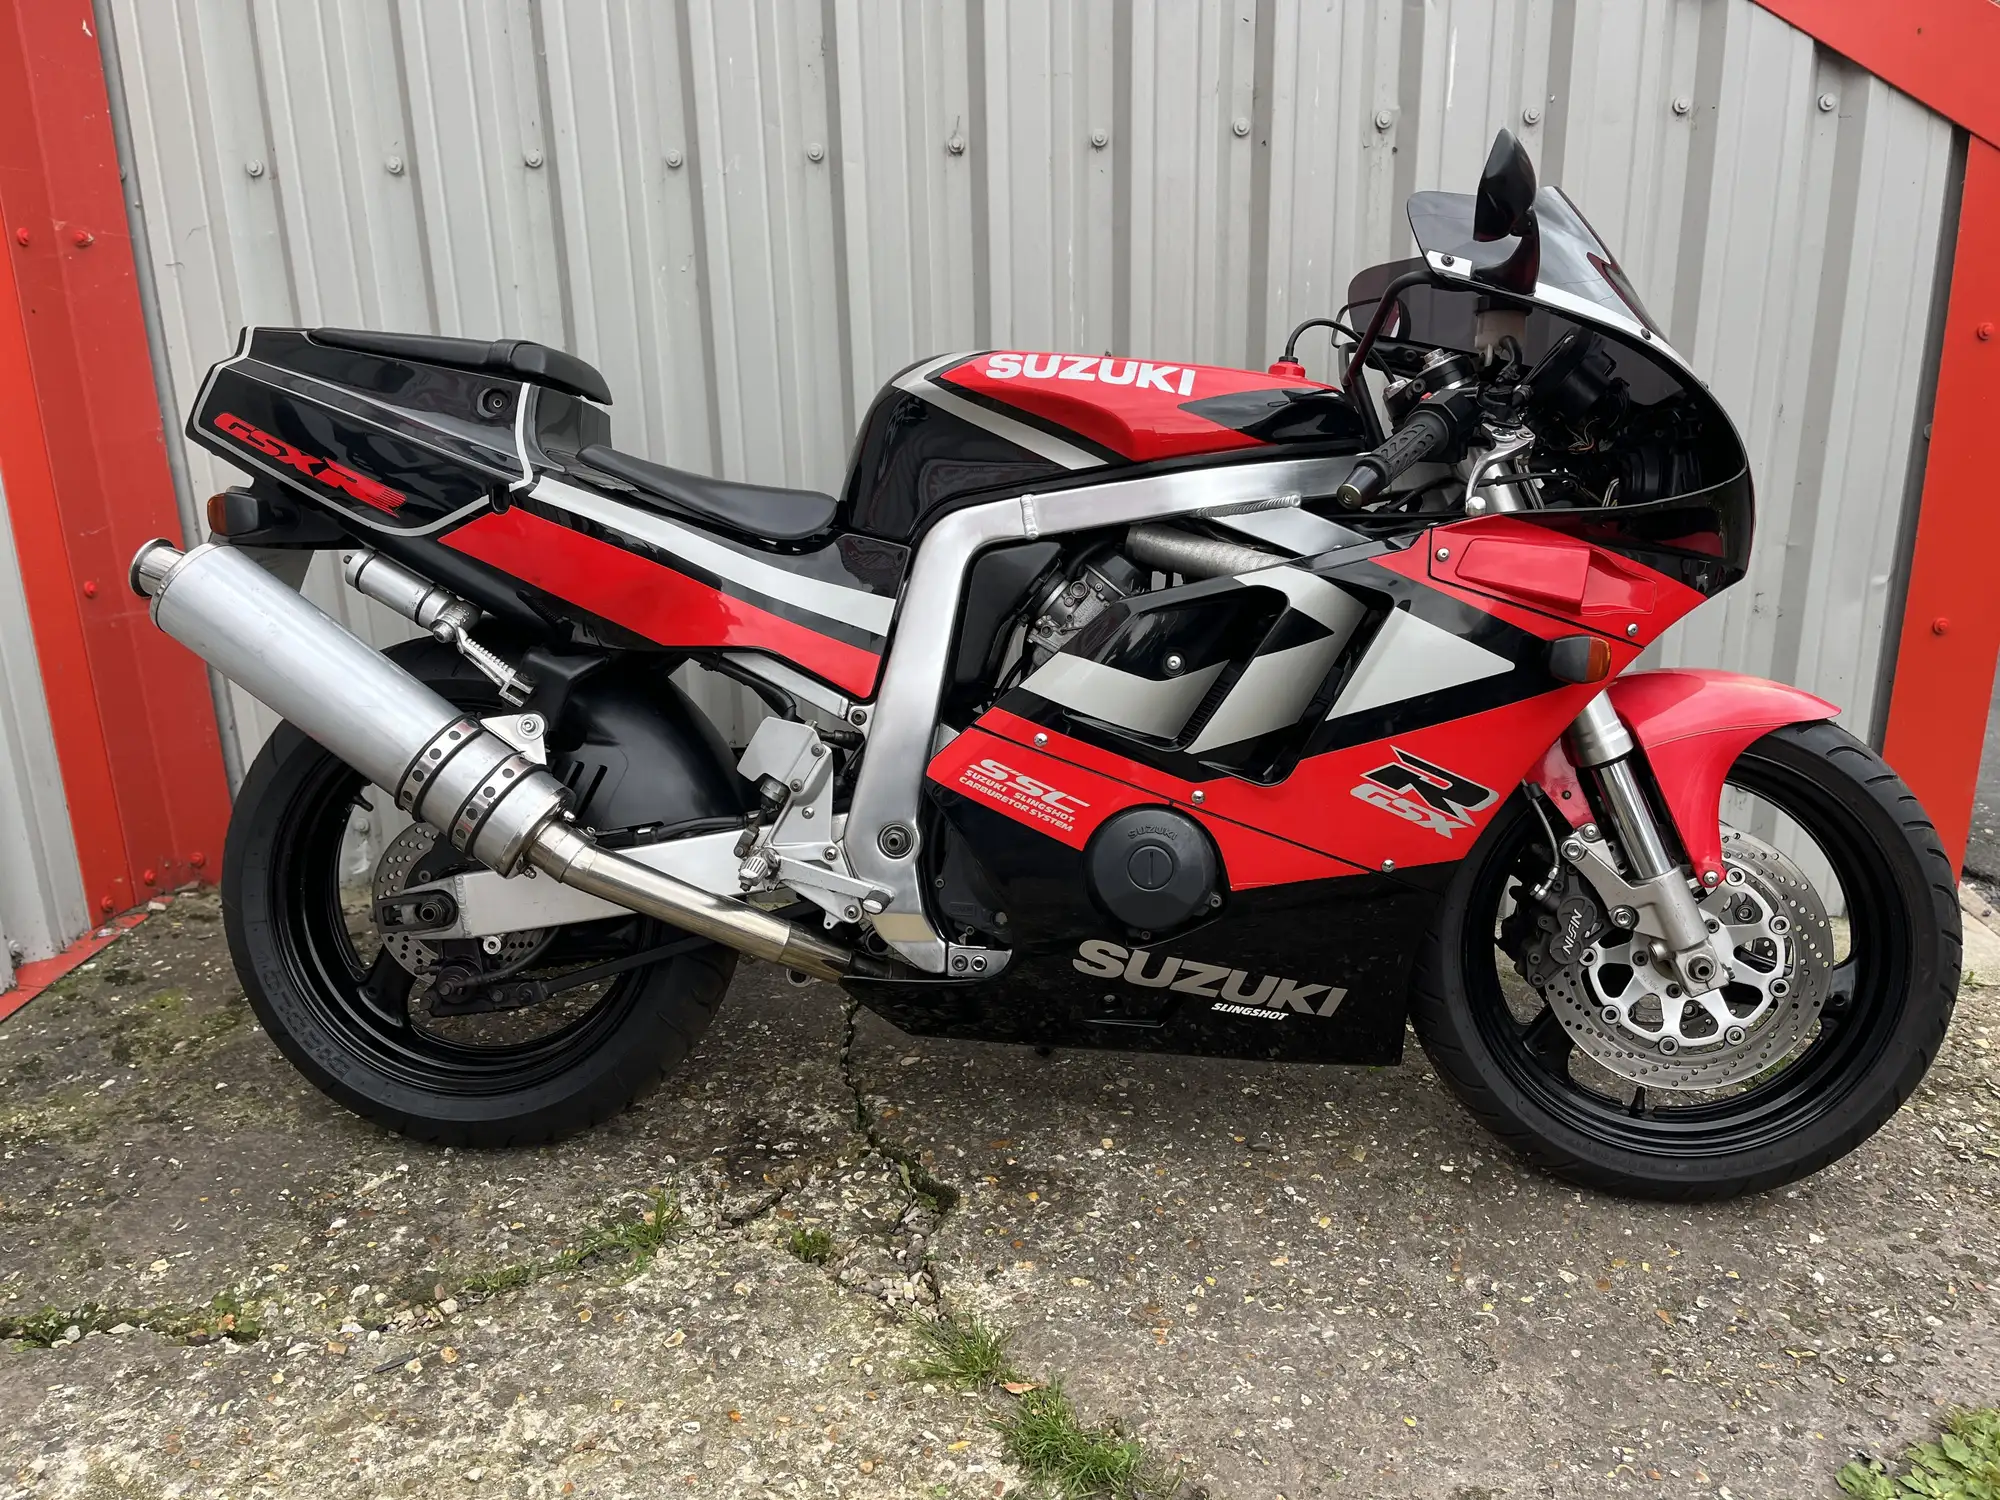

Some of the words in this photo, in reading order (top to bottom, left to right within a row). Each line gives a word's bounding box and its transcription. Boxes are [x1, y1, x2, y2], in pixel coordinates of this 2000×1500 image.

[985, 353, 1196, 396] SUZUKI
[959, 776, 1030, 812] CARBURETOR
[1029, 806, 1074, 832] SYSTEM
[965, 769, 1008, 792] SUZUKI
[1013, 792, 1076, 823] SLINGSHOT
[968, 758, 1091, 814] SSC
[1350, 783, 1468, 839] GSX
[1360, 744, 1500, 827] R
[1127, 825, 1178, 841] SUZUKI
[1072, 939, 1348, 1018] SUZUKI
[1211, 1002, 1289, 1021] SLINGSHOT
